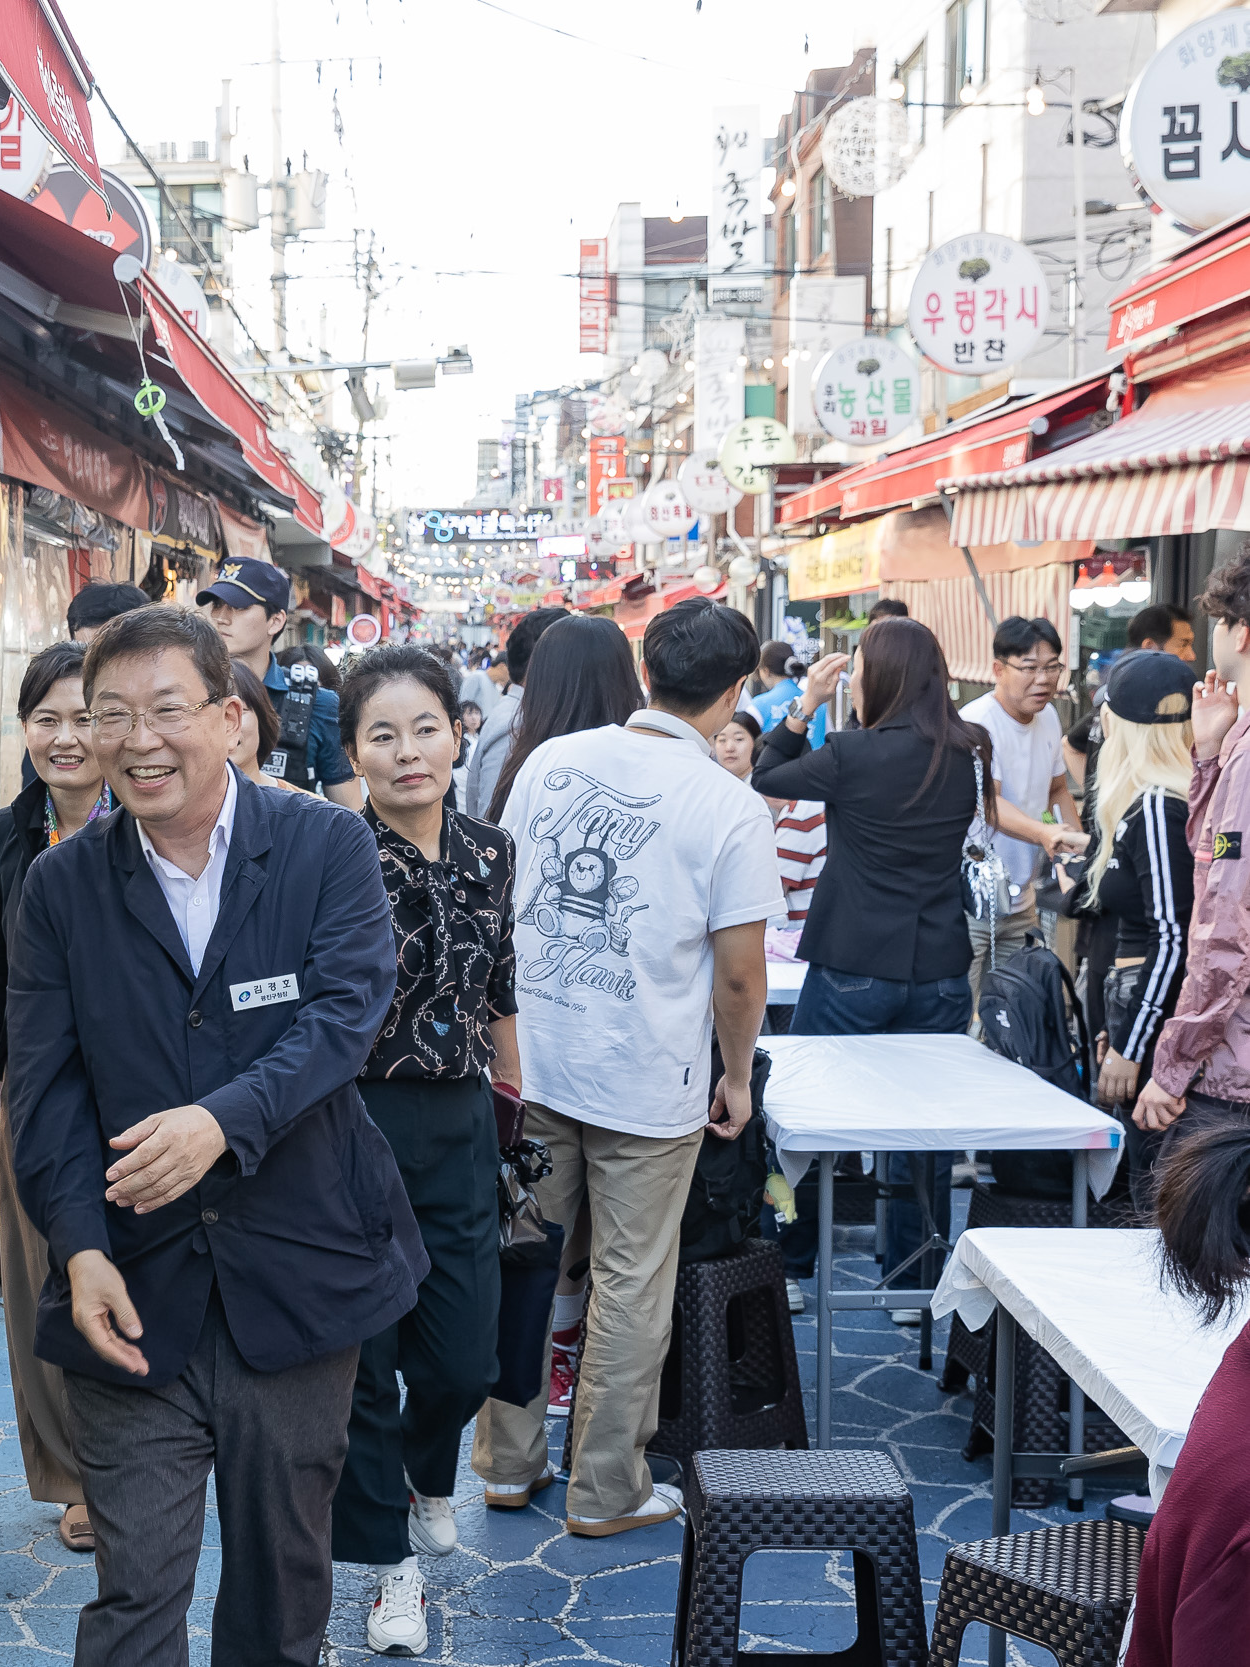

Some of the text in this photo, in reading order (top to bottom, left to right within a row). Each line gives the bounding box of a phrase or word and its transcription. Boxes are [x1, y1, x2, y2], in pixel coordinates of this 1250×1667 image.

[922, 286, 1038, 335] 우렁각시
[954, 339, 1005, 364] 반찬
[839, 379, 911, 418] 농산물
[850, 419, 887, 437] 과일
[529, 767, 662, 860] Tony
[253, 979, 292, 995] 김경호
[523, 939, 637, 1001] Hawk
